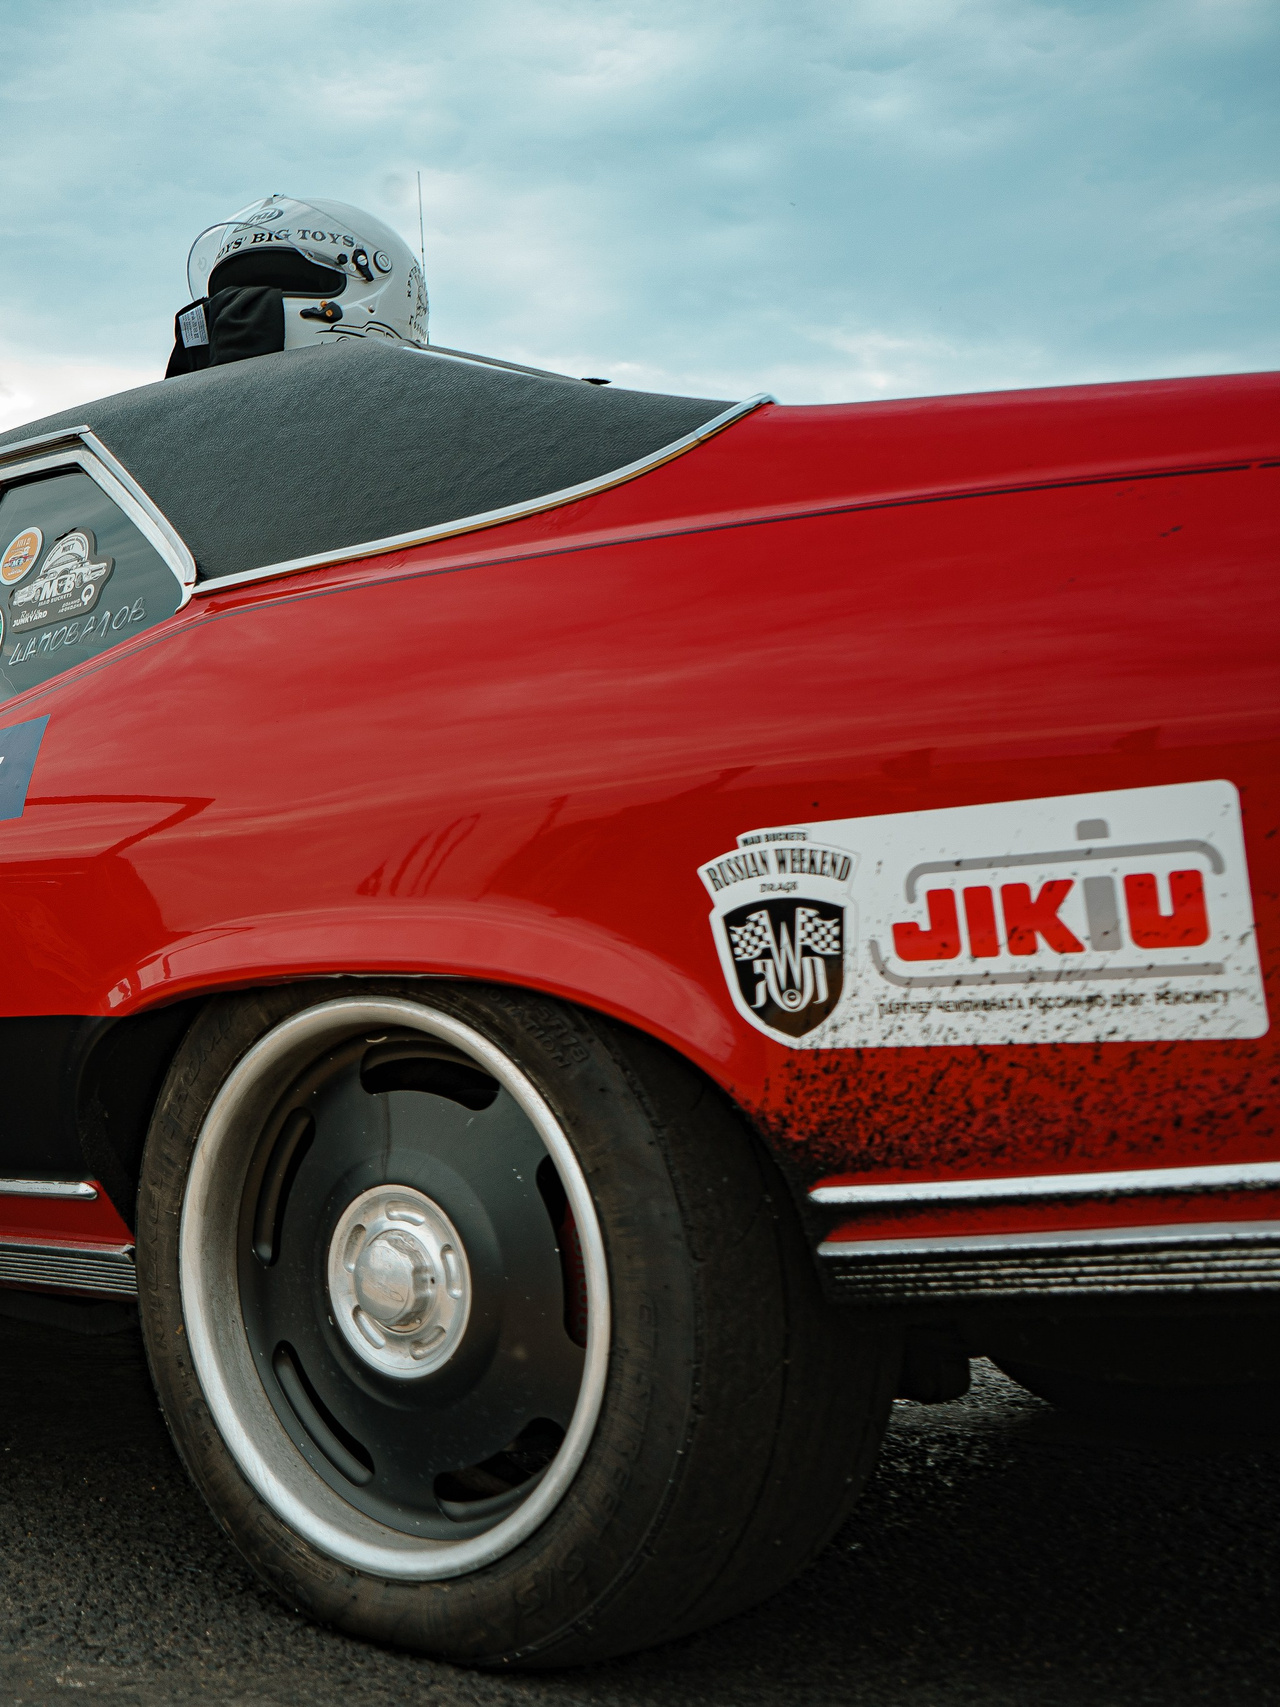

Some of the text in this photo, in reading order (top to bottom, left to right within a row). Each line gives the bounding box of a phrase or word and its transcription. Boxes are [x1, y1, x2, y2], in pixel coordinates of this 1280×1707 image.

[250, 229, 293, 244] BIG
[297, 229, 355, 248] TOYS
[742, 831, 808, 847] MAD BUCKETS
[704, 848, 853, 893] RUSSIAN WEEKEND
